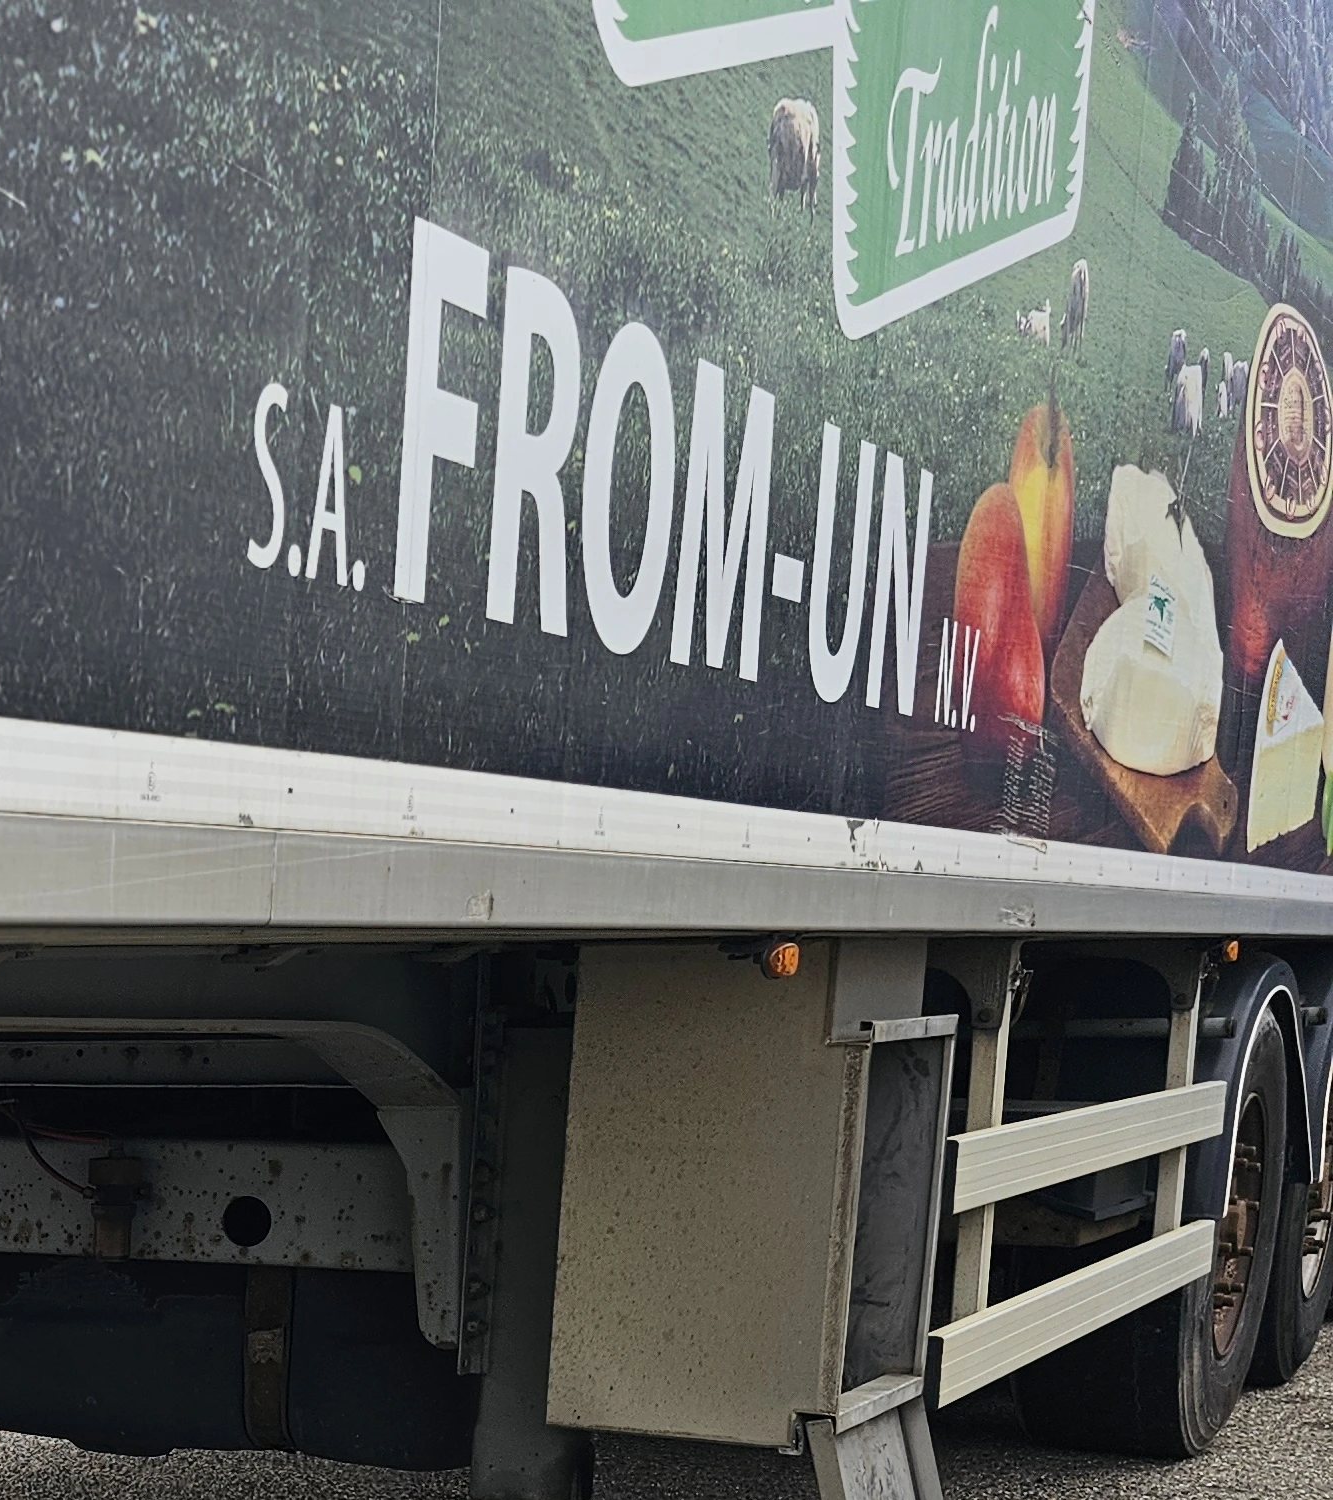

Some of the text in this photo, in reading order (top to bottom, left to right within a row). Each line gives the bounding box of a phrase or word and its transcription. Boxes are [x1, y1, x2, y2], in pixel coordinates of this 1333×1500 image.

[886, 4, 1057, 258] Tradition
[247, 215, 981, 733] S.A. FROM-UN N.V.
